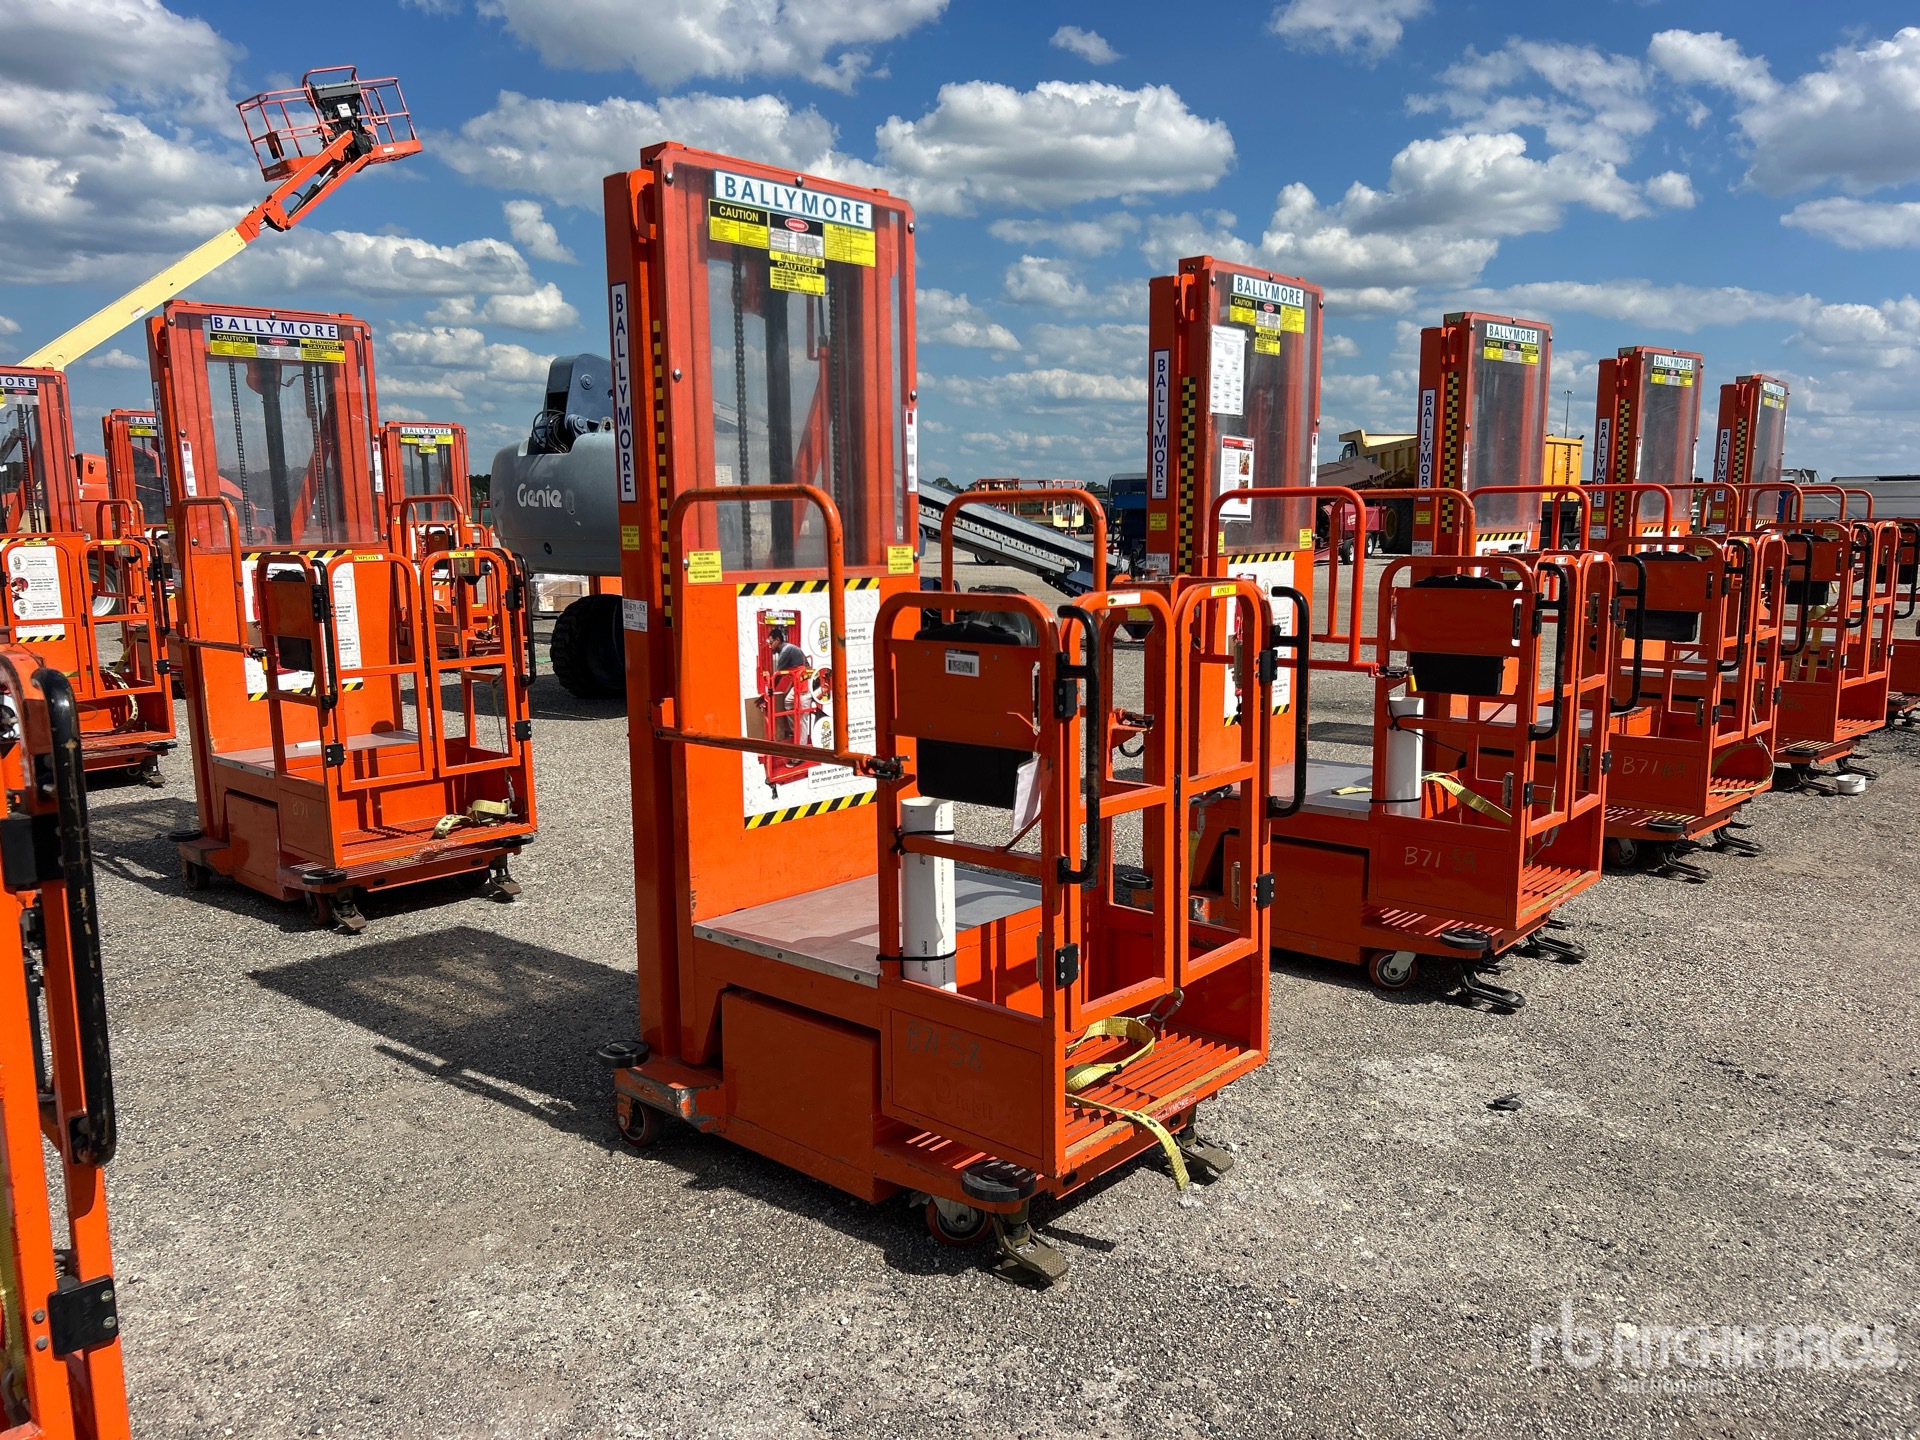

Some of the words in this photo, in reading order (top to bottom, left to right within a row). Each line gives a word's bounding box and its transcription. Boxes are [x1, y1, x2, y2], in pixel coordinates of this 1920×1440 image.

[725, 176, 864, 224] BALLYMORE
[719, 205, 759, 223] CAUTION
[777, 262, 818, 274] CAUTION
[1237, 278, 1300, 305] BALLYMORE
[1234, 298, 1252, 307] CAUTION
[214, 317, 336, 338] BALLYMORE
[1490, 325, 1535, 342] BALLYMORE
[216, 334, 249, 343] CAUTION
[1655, 356, 1691, 369] BALLYMORE
[615, 294, 632, 493] BALLYMORE
[1155, 359, 1166, 492] BALLYMORE
[154, 388, 169, 501] BALLYMORE
[1420, 395, 1432, 488] BALLYMOR
[517, 483, 562, 507] Genie
[1217, 586, 1231, 594] ONLY
[1622, 756, 1658, 775] B71
[1405, 846, 1441, 868] B71
